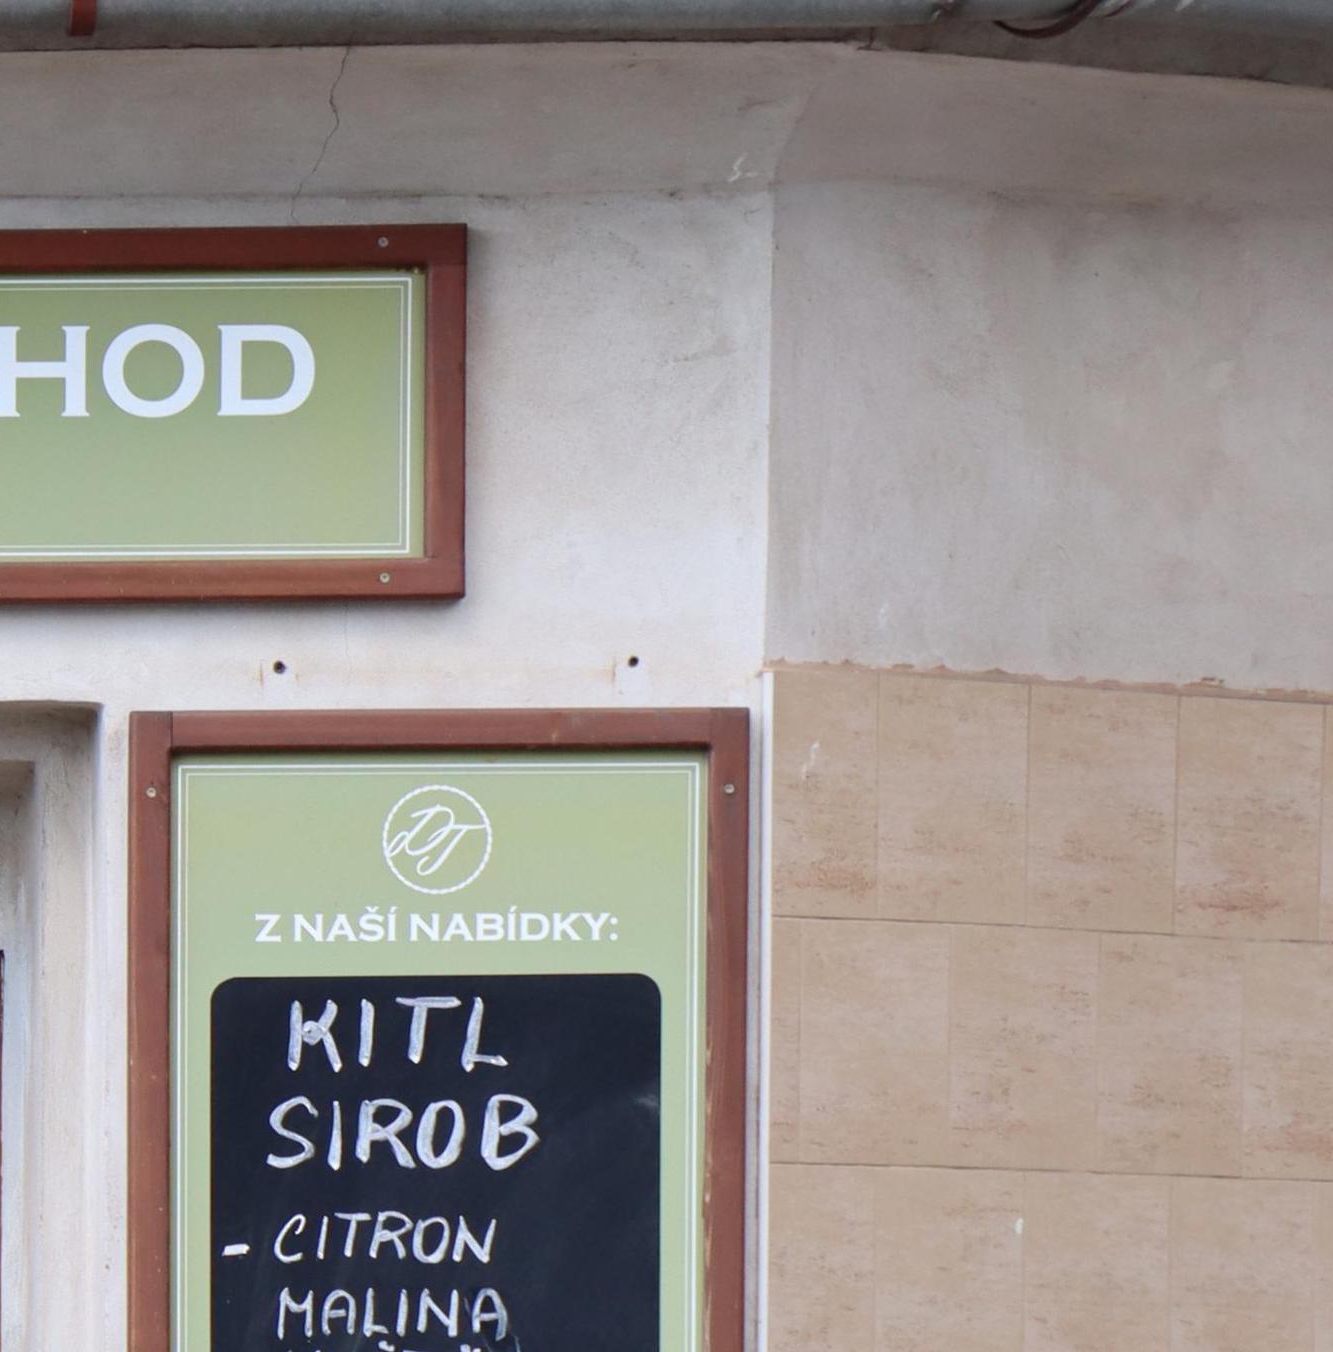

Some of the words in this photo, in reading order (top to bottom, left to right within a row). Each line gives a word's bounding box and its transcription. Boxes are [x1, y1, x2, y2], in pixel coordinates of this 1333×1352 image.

[255, 914, 281, 942] Z
[294, 907, 395, 942] NAŠÍ
[410, 907, 618, 941] NABÍDKY:
[288, 996, 508, 1072] KITL
[267, 1094, 540, 1170] SIROB
[274, 1211, 496, 1264] CITRON
[277, 1287, 509, 1341] MALINA
